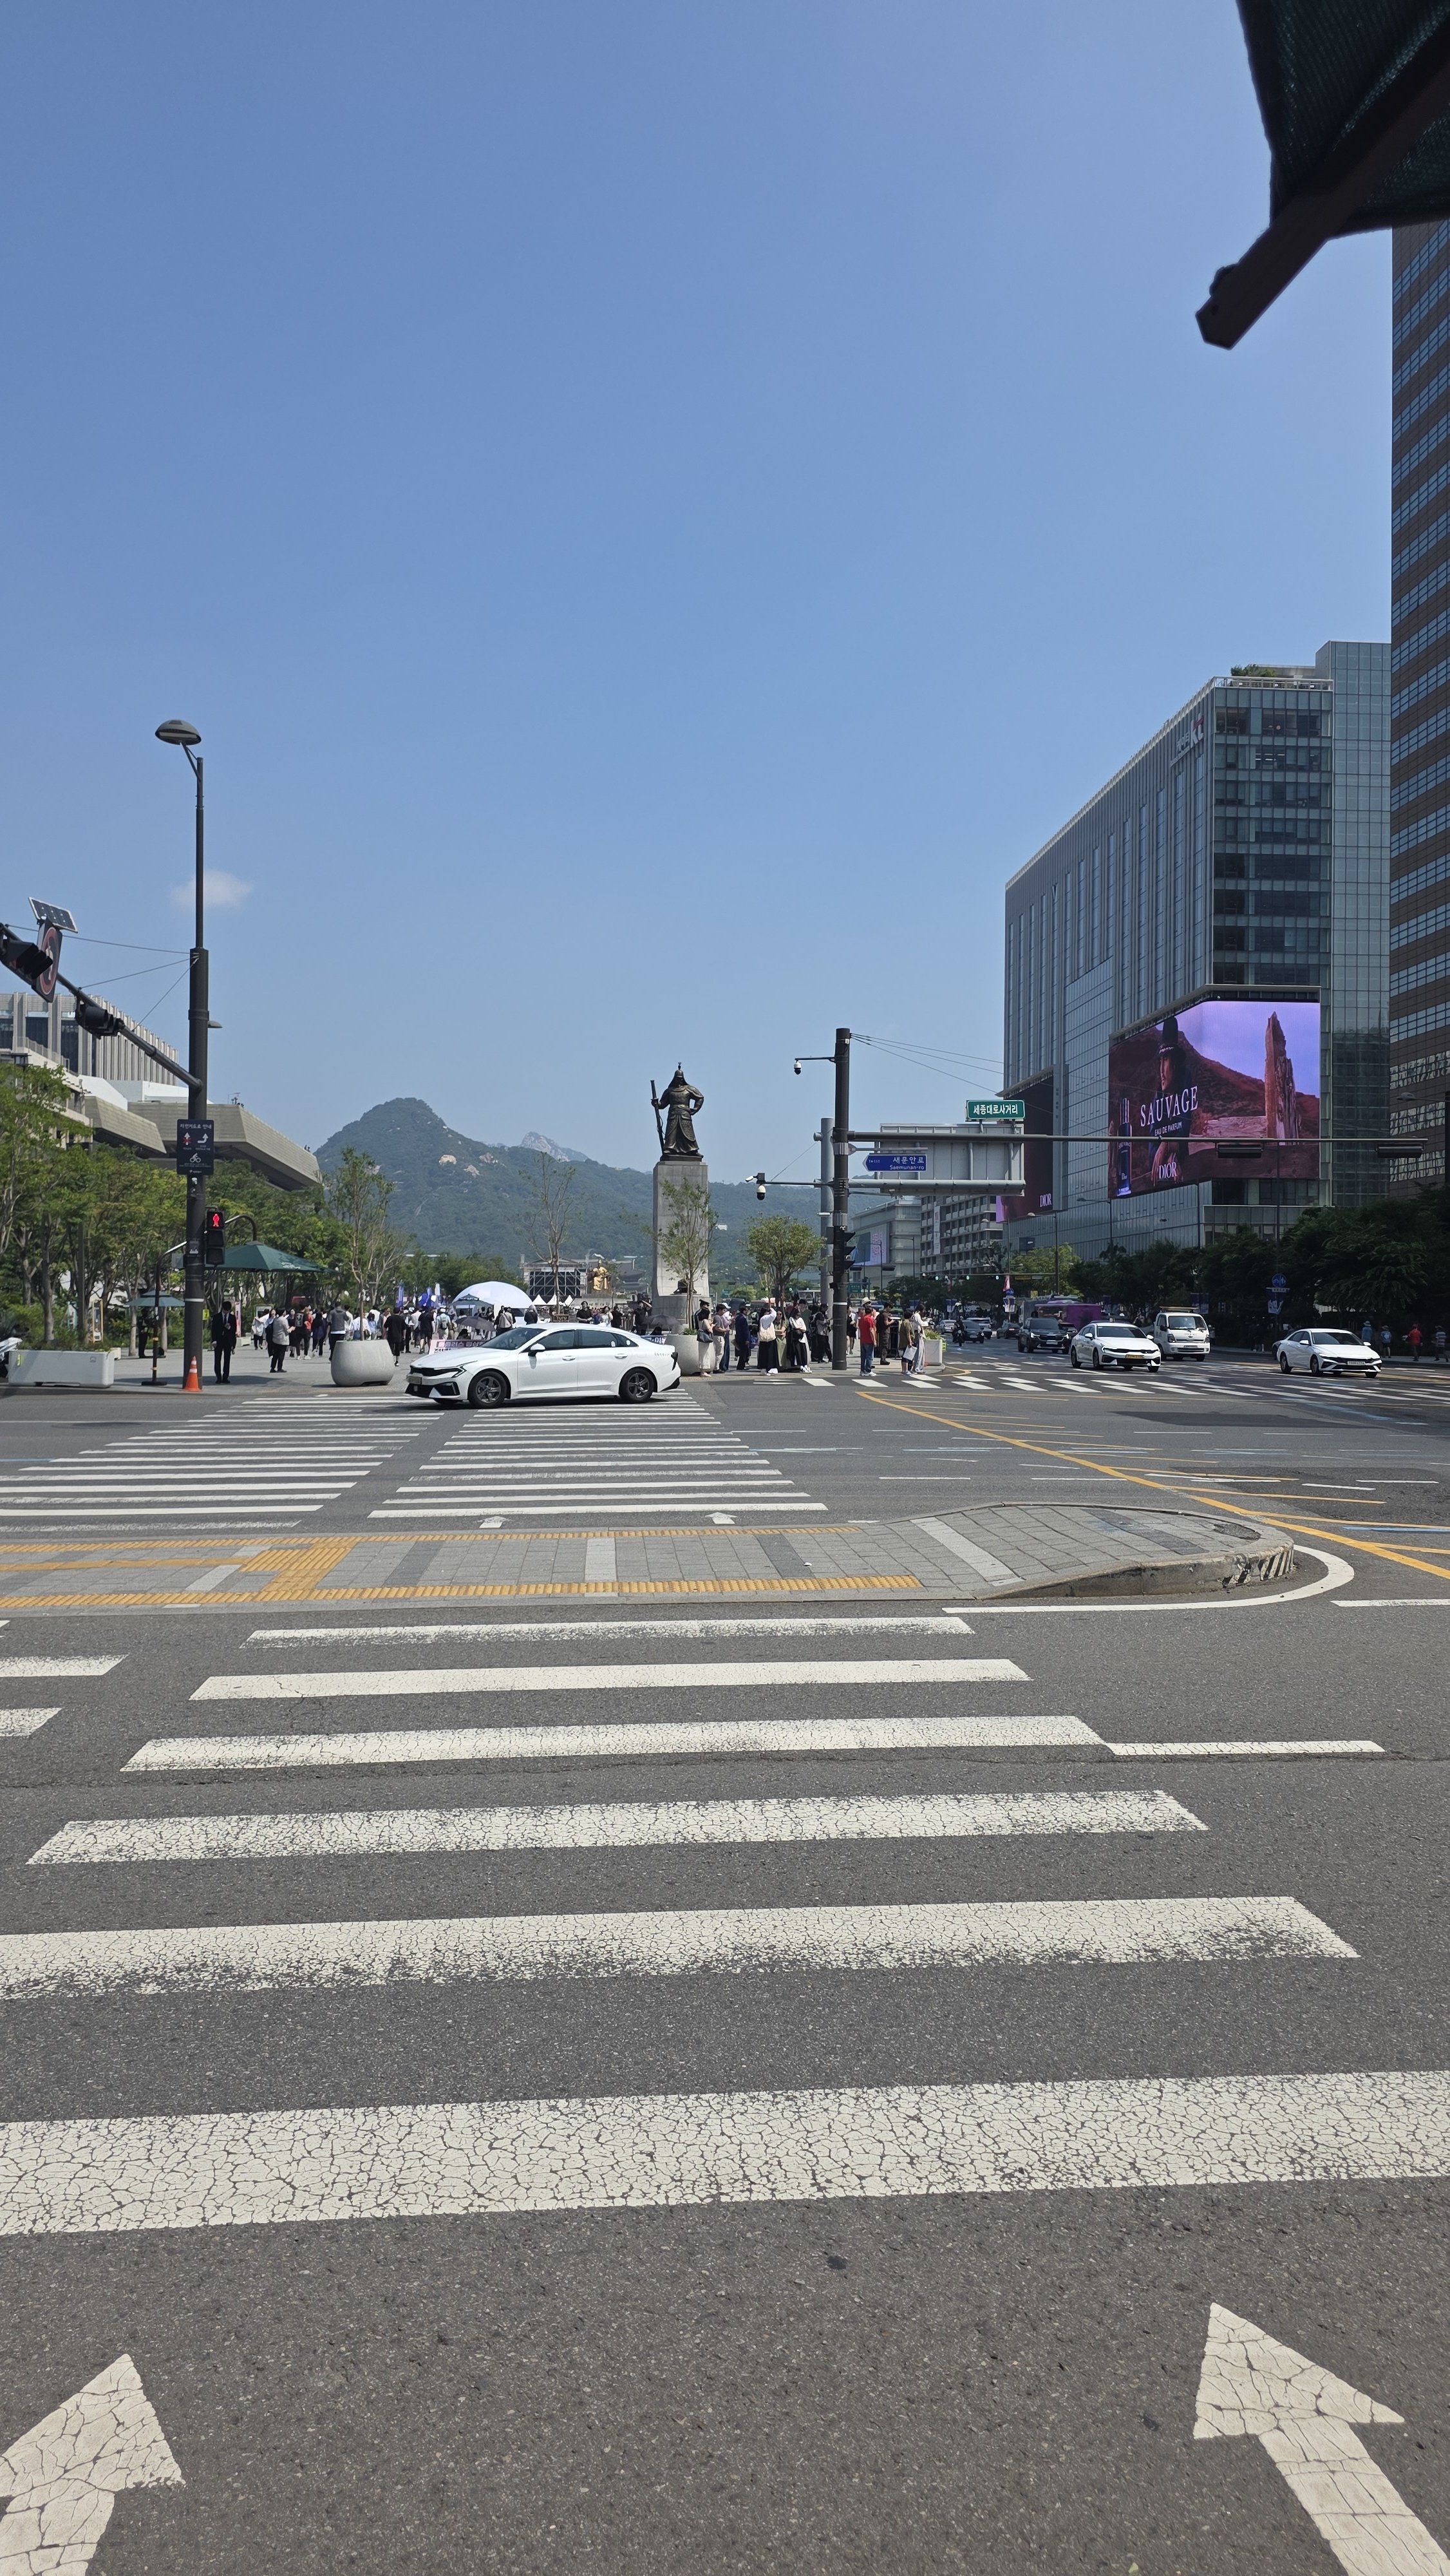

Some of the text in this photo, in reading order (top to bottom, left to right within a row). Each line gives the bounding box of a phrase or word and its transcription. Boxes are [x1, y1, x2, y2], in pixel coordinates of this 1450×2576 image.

[974, 1104, 1018, 1115] 세종대로사거리
[1140, 1086, 1198, 1127] SAUVAGE
[1167, 1121, 1182, 1132] PARFUM
[1159, 1162, 1177, 1179] DIOR
[1040, 1193, 1052, 1208] DIOR
